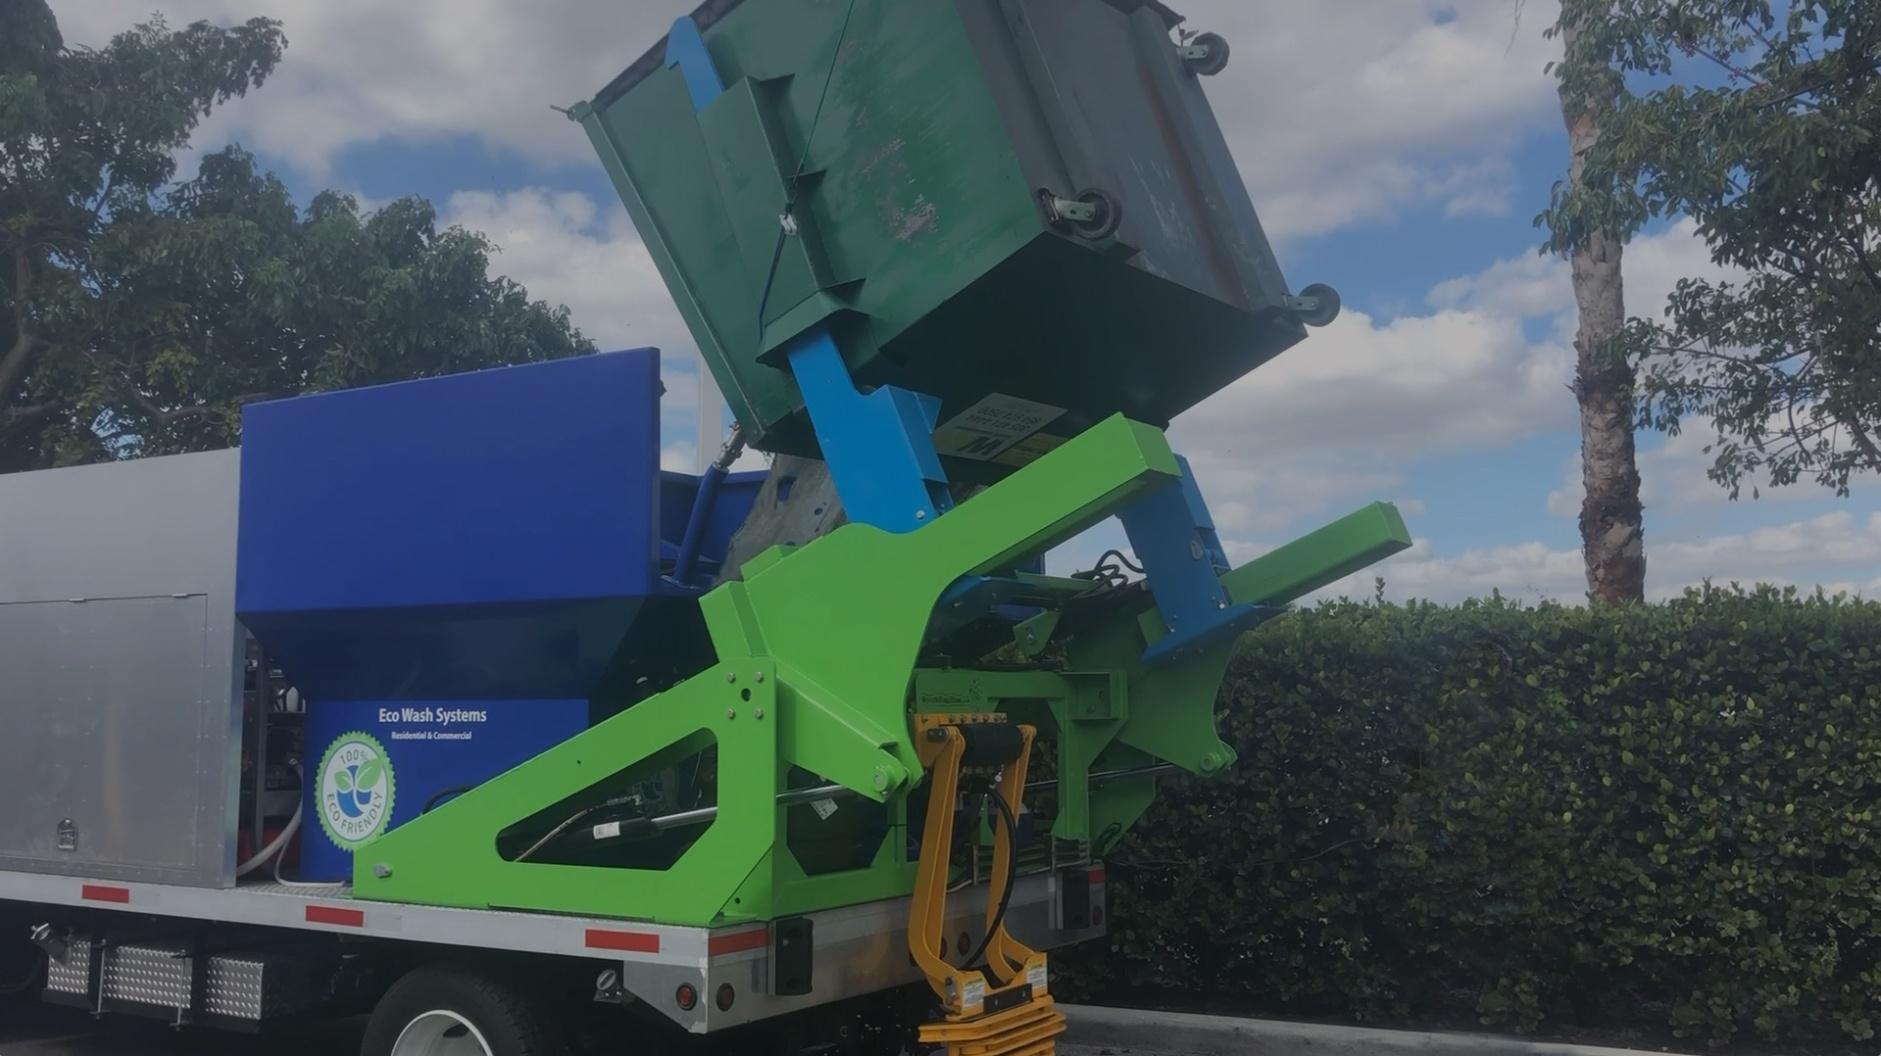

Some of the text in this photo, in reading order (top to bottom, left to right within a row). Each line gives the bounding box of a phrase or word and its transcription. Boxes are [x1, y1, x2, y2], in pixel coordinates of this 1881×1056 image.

[379, 707, 487, 726] Eco Wash Systems
[391, 731, 427, 740] Residential
[433, 731, 472, 740] Commercial
[341, 749, 369, 764] 100%
[327, 792, 383, 834] ECO FRIENDLY
